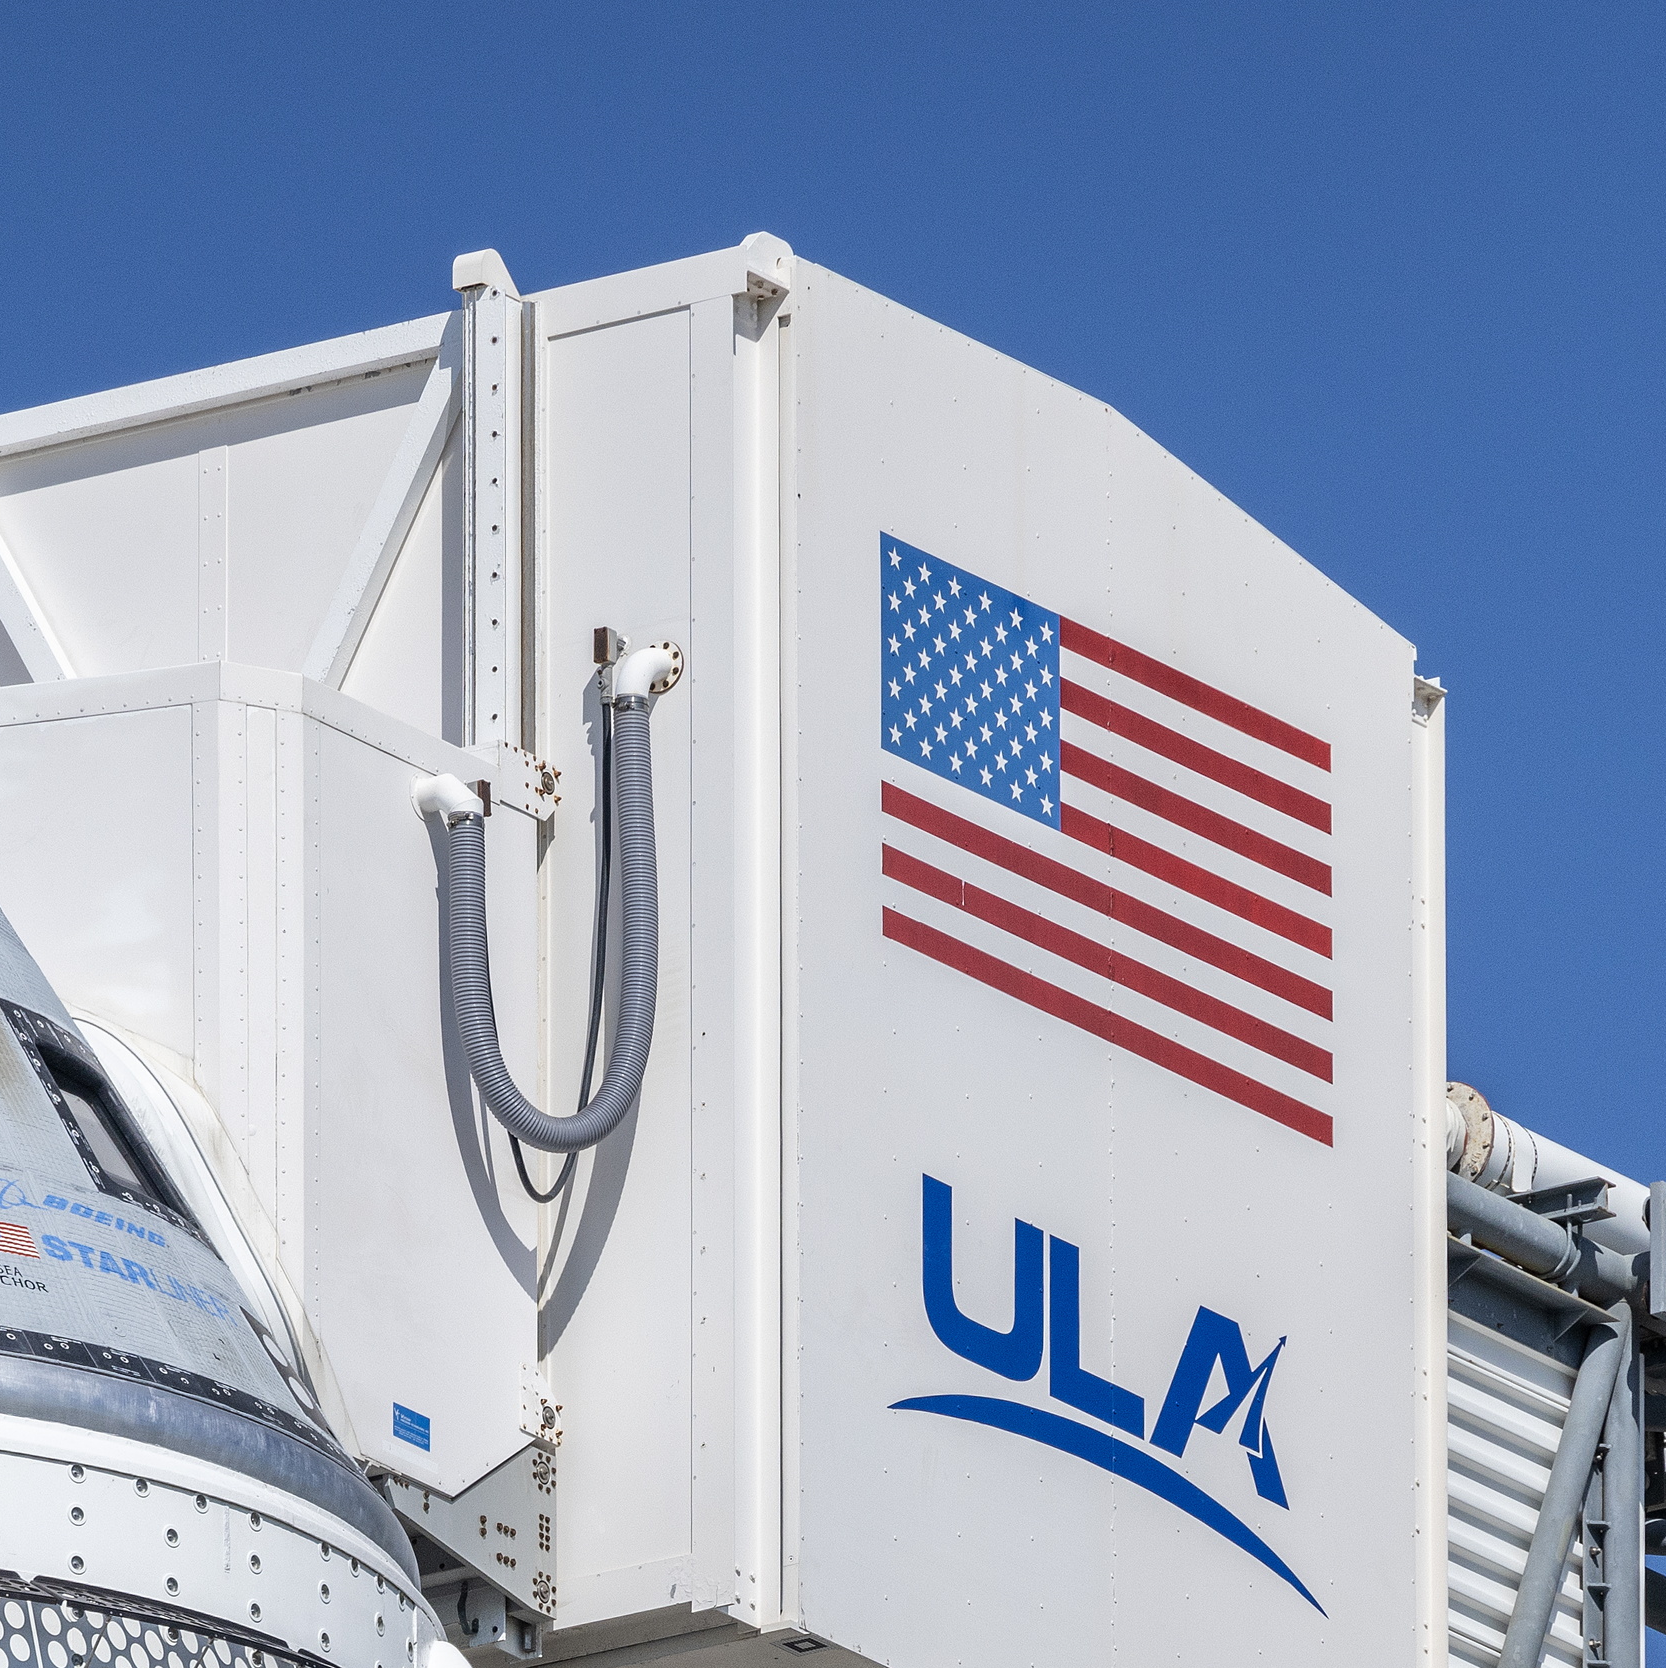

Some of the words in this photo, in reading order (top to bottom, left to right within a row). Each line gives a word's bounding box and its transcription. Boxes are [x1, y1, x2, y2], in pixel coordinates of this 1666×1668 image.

[42, 1194, 166, 1247] BOEING
[41, 1234, 237, 1327] STARLINER
[922, 1172, 1290, 1511] ULA
